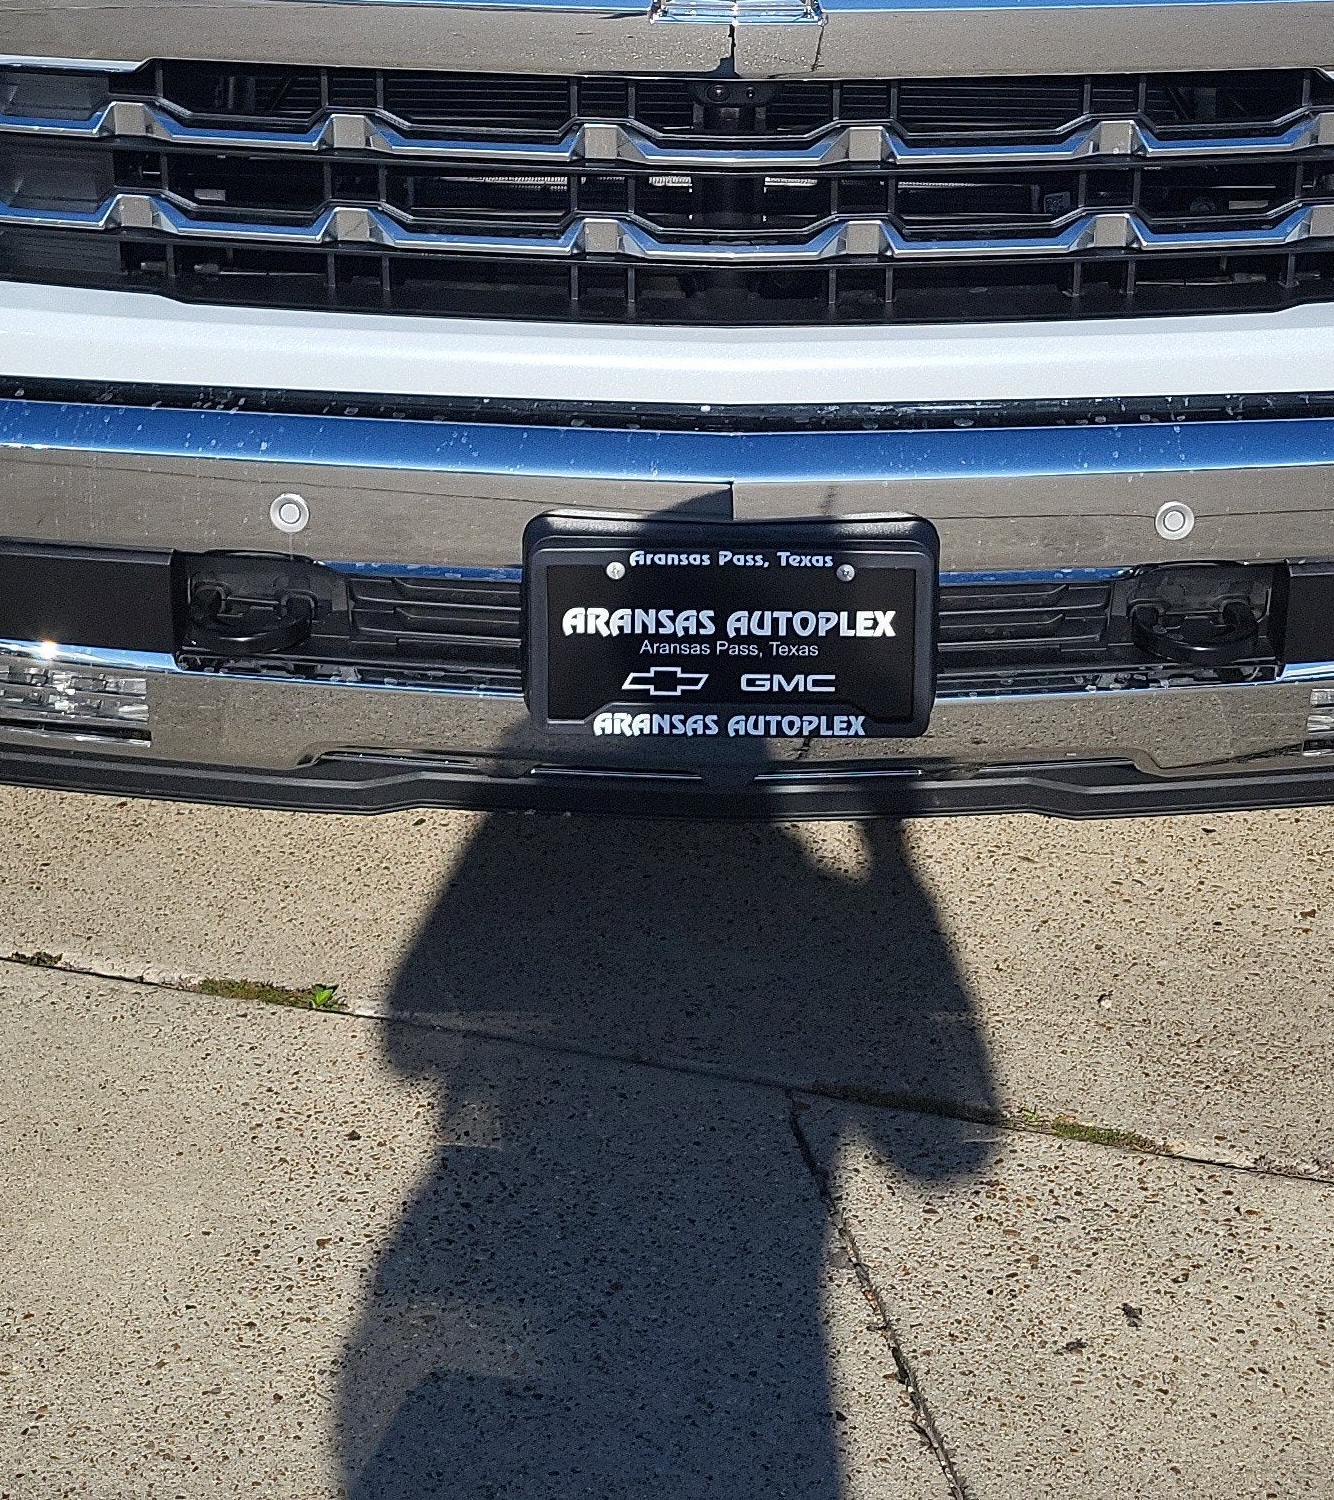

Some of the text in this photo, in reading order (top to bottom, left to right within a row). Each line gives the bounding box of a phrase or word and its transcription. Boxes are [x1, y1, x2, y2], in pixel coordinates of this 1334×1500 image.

[629, 550, 834, 568] Aransas Pass, Texas
[562, 607, 897, 638] ARANSAS AUTOPLEX
[639, 639, 819, 658] Aransas Pass, Texas
[740, 673, 836, 692] GMC
[593, 711, 866, 737] ARANSAS AUTOPLEX
